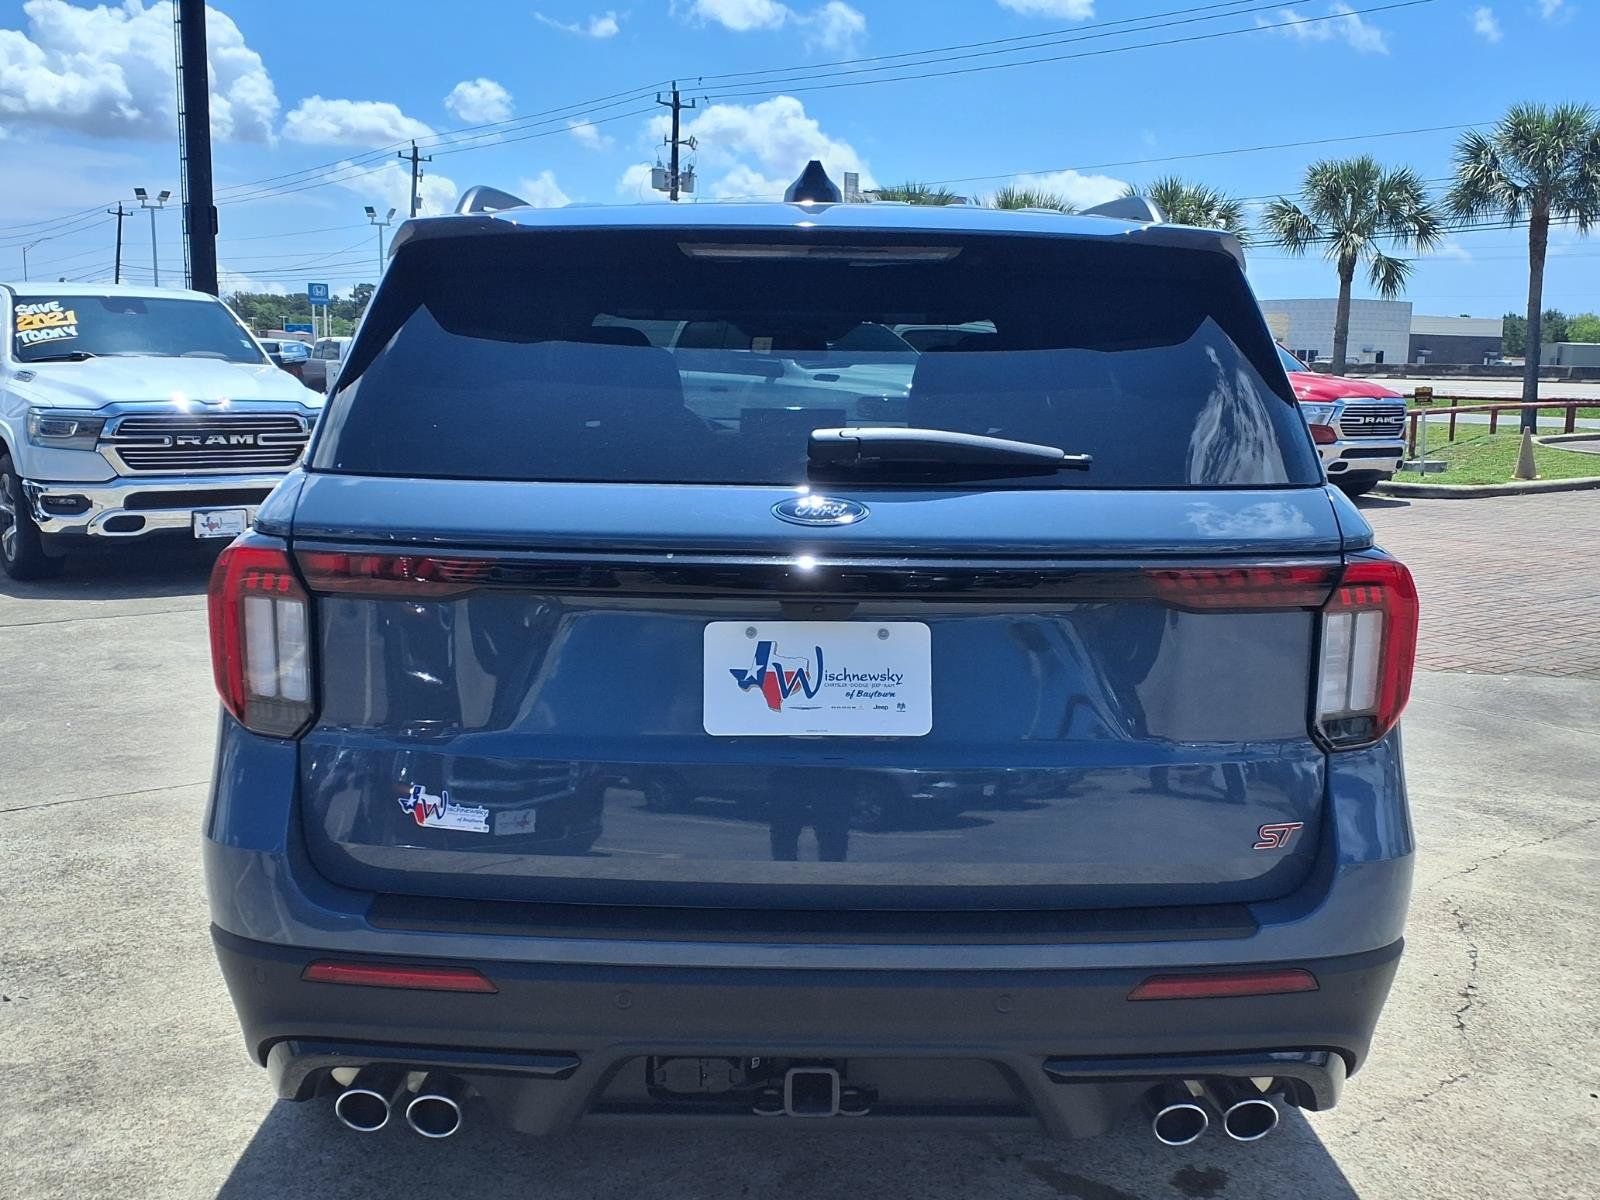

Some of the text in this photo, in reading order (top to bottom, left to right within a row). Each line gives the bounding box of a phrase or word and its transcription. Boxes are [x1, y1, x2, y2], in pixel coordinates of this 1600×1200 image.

[14, 301, 64, 316] SAVE
[16, 310, 78, 331] 2021
[15, 326, 78, 343] TODAY
[176, 434, 254, 445] RAM
[845, 689, 896, 700] of Baytown
[1253, 822, 1304, 850] ST
